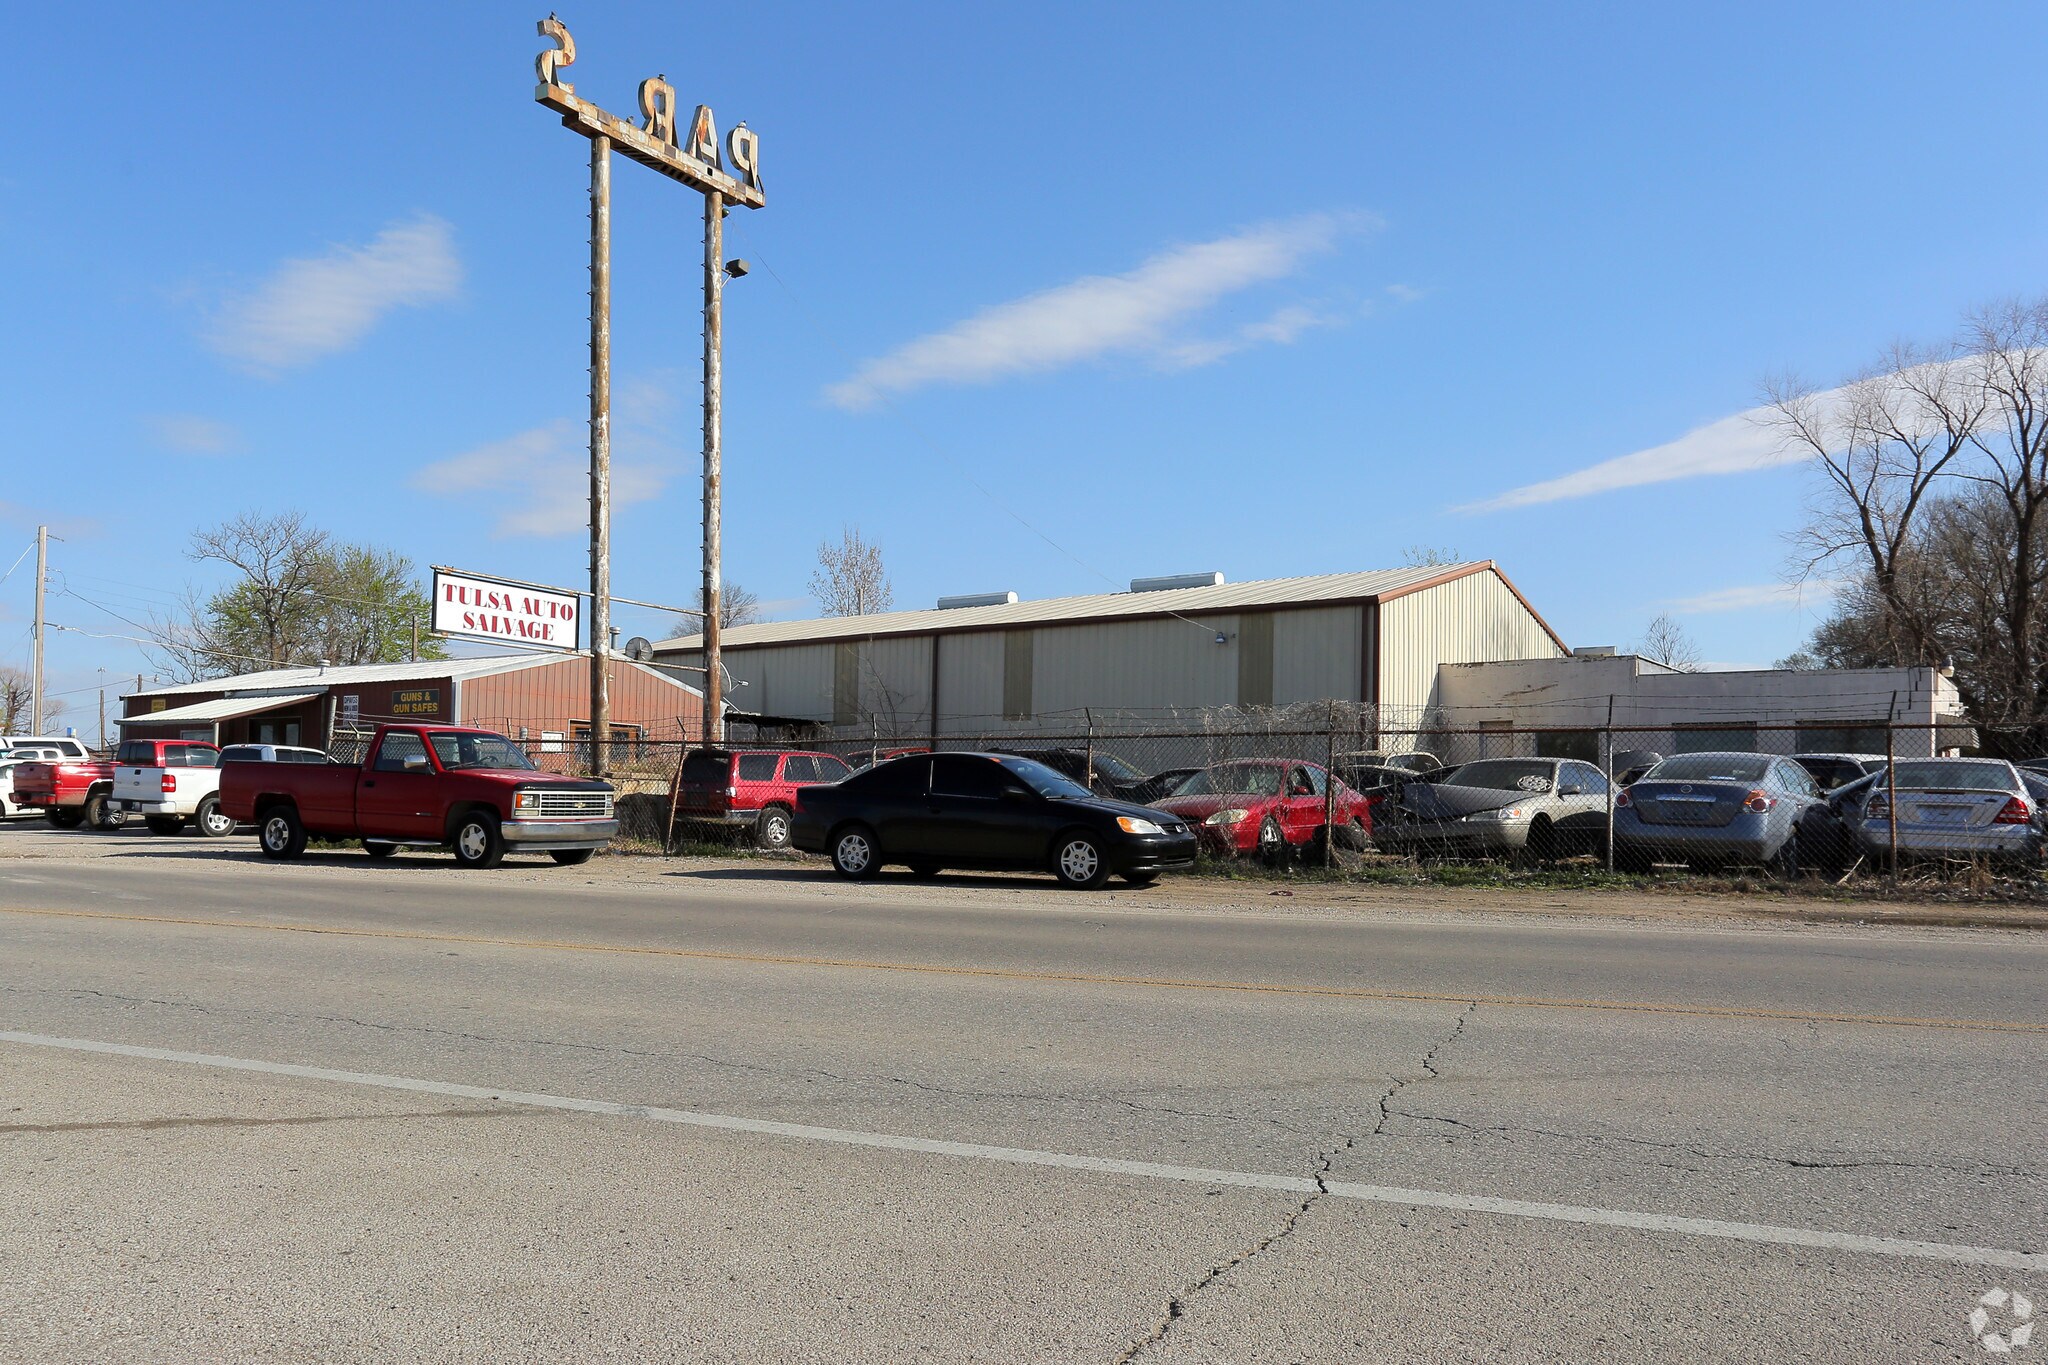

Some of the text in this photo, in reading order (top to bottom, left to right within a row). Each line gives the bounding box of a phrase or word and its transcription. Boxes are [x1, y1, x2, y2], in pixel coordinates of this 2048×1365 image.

[442, 583, 574, 621] TULSA AUTO
[462, 611, 554, 641] SALVAGE
[400, 691, 431, 702] GUNS &
[393, 702, 438, 713] GUN SAFES
